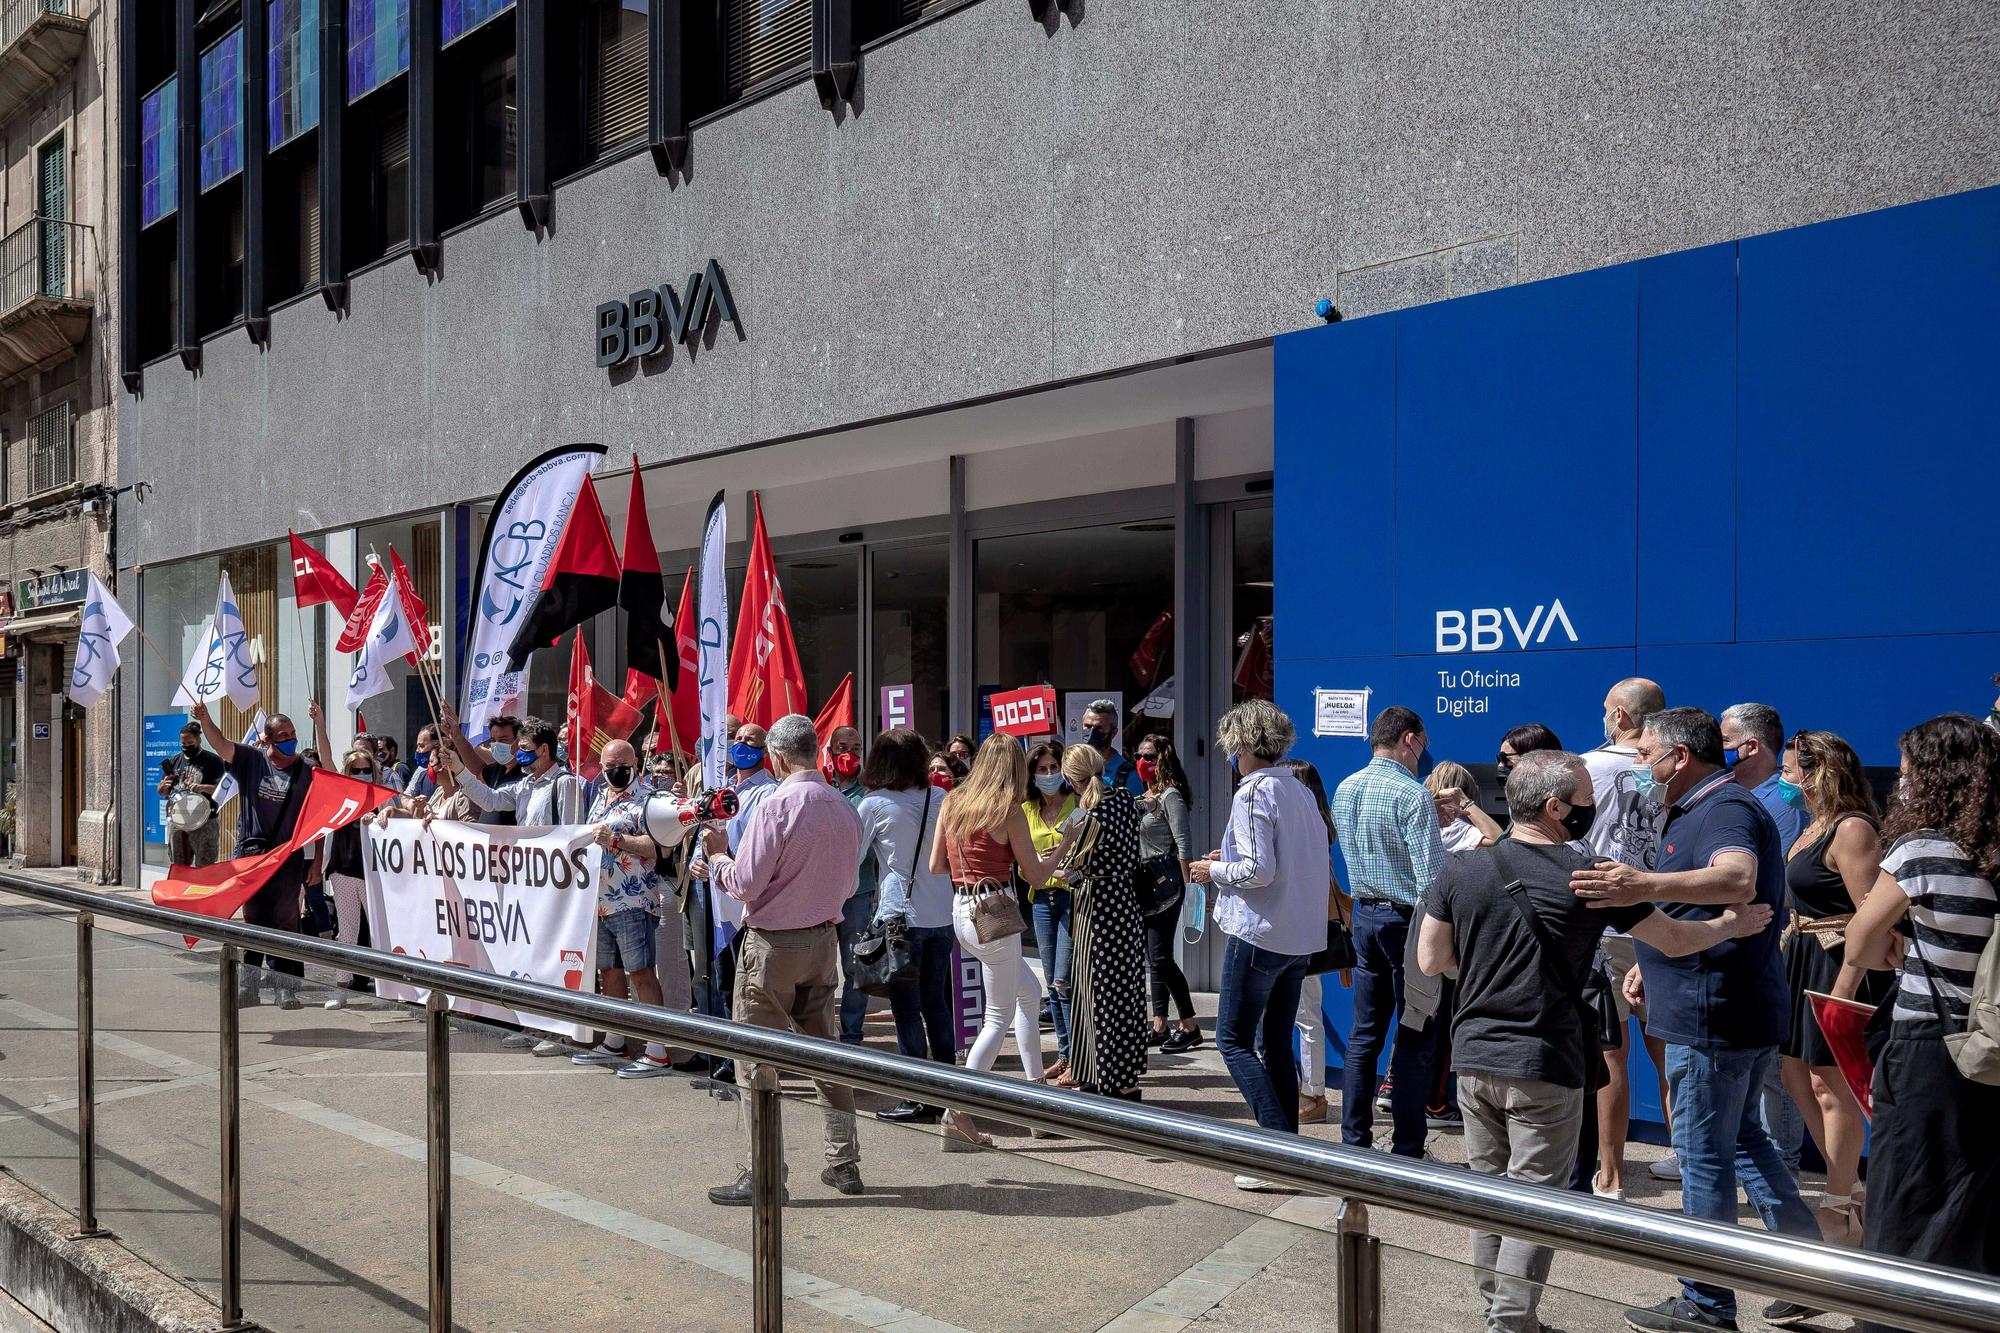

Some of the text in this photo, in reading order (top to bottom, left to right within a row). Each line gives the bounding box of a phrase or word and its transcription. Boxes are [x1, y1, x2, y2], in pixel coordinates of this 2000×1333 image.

[596, 259, 735, 368] BBVA
[504, 452, 587, 516] sede@acb-sbbva.com
[553, 491, 577, 528] BANCA
[491, 519, 546, 590] ACB
[1436, 597, 1579, 653] BBVA
[1437, 669, 1521, 688] Tu Oficina
[35, 725, 48, 735] BC
[993, 697, 1045, 727] CCOO
[1436, 696, 1489, 718] Digital
[371, 837, 590, 890] NO A LOS DESPIDOS
[435, 898, 531, 946] EN BBVA
